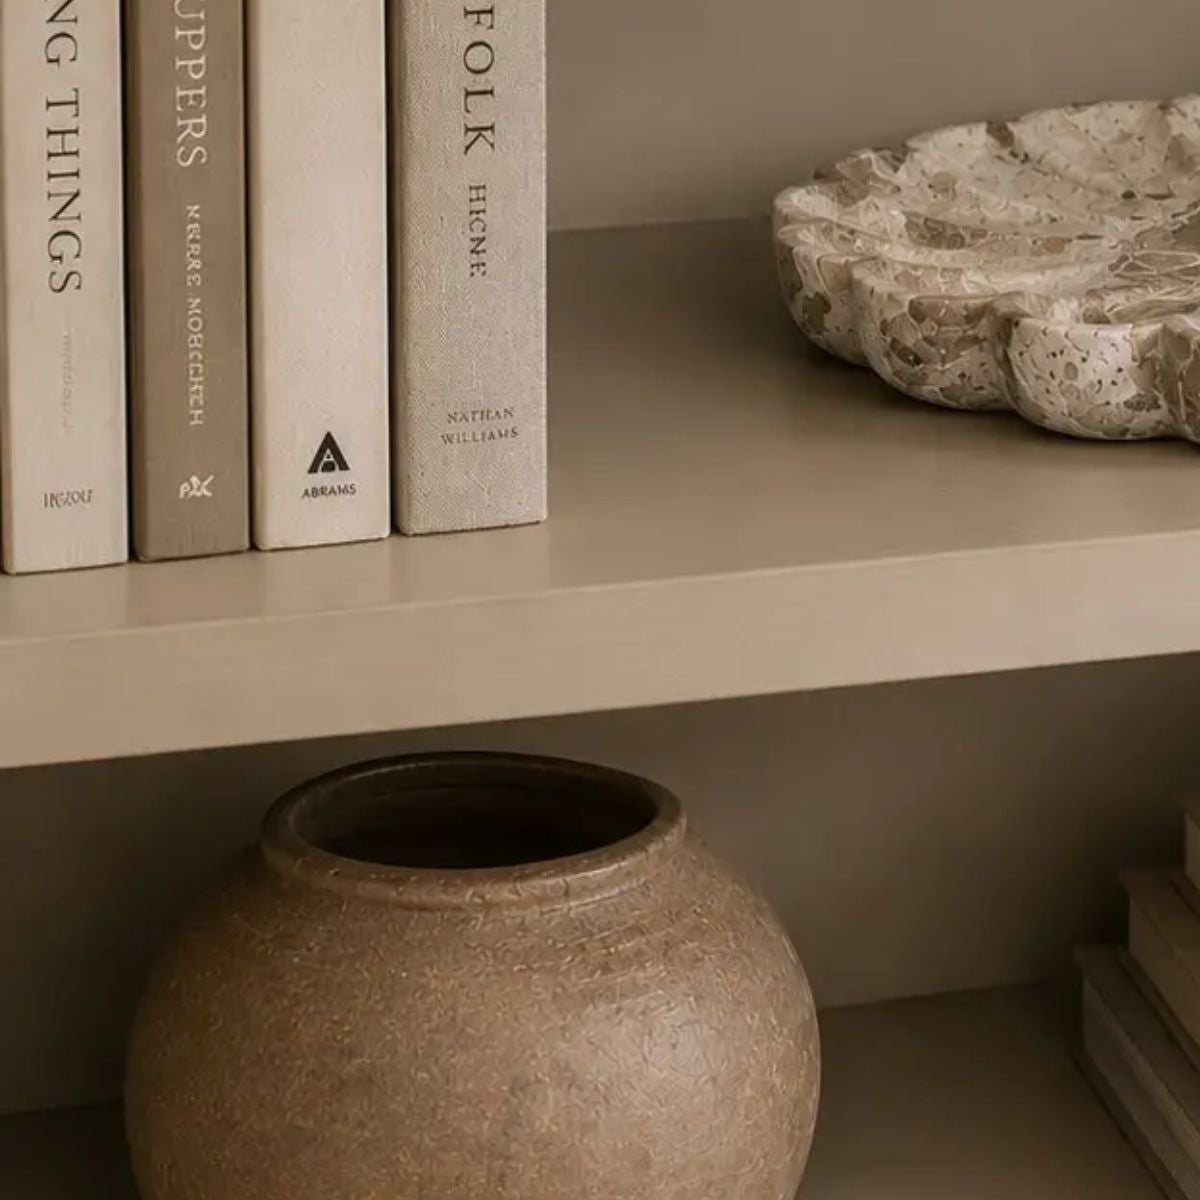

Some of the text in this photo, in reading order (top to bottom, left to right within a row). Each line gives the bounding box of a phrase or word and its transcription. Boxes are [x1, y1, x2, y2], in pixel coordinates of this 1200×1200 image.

[46, 88, 81, 293] THINGS
[447, 407, 513, 424] NATHAN
[441, 427, 518, 445] WILLIAMS
[302, 484, 356, 498] ABRAMS
